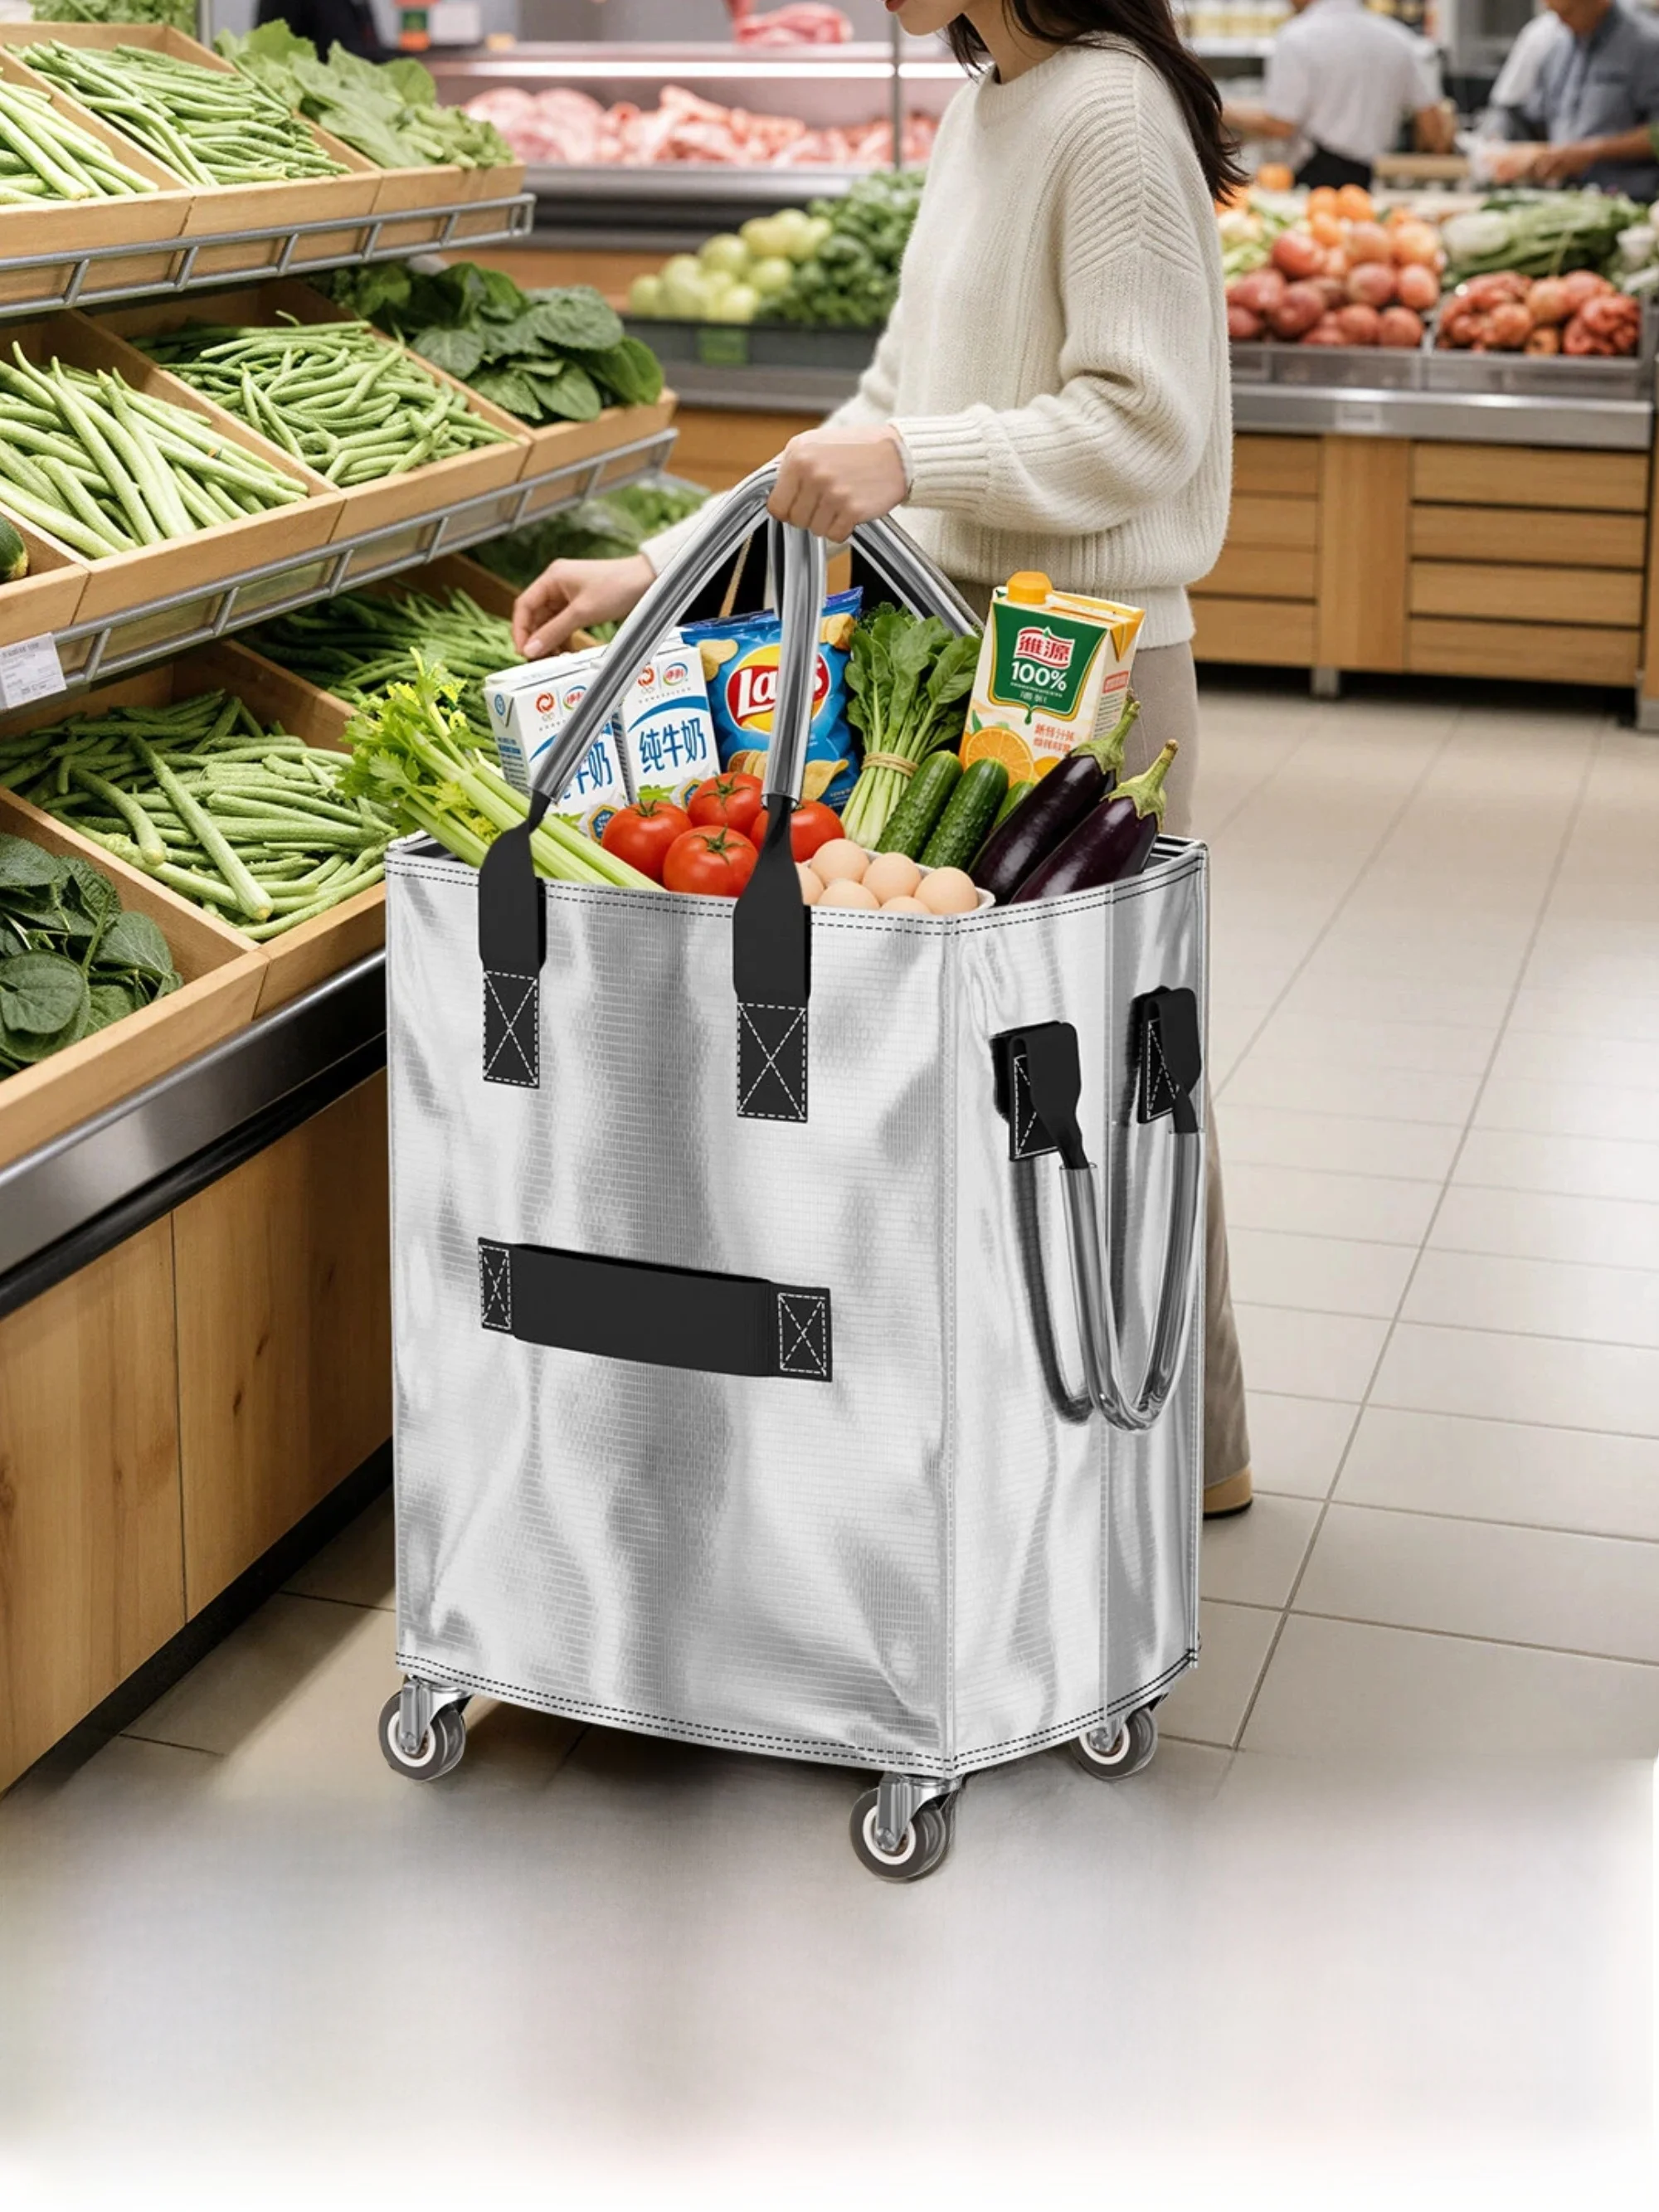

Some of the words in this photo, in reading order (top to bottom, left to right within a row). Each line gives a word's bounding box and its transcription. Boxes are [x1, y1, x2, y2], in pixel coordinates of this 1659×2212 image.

[737, 663, 823, 719] Las
[1012, 661, 1068, 691] 100%
[639, 717, 707, 773] 纯牛奶
